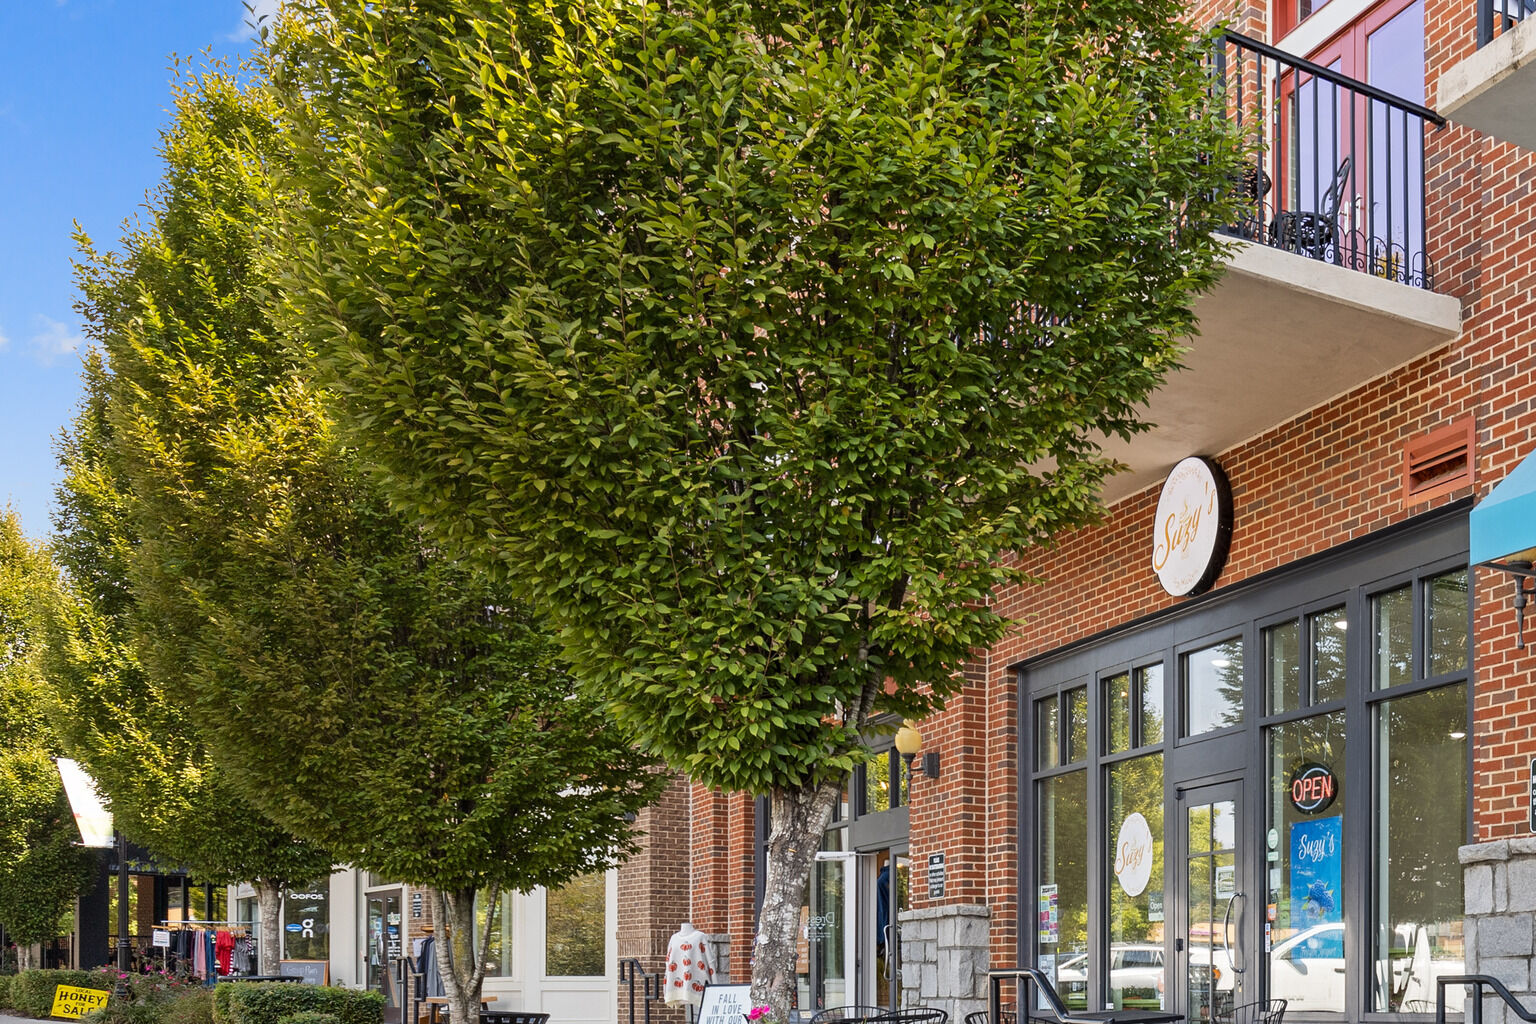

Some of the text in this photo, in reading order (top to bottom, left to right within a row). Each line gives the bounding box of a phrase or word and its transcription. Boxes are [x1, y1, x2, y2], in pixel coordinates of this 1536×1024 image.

[1154, 481, 1215, 571] Suzy's
[1292, 775, 1332, 803] OPEN
[1114, 830, 1153, 875] Suzy's
[1299, 831, 1335, 862] Suzy's
[59, 991, 104, 1005] HONEY
[719, 994, 736, 1003] FALL
[712, 1004, 742, 1014] IN LOVE
[707, 1016, 742, 1024] WITH OUR
